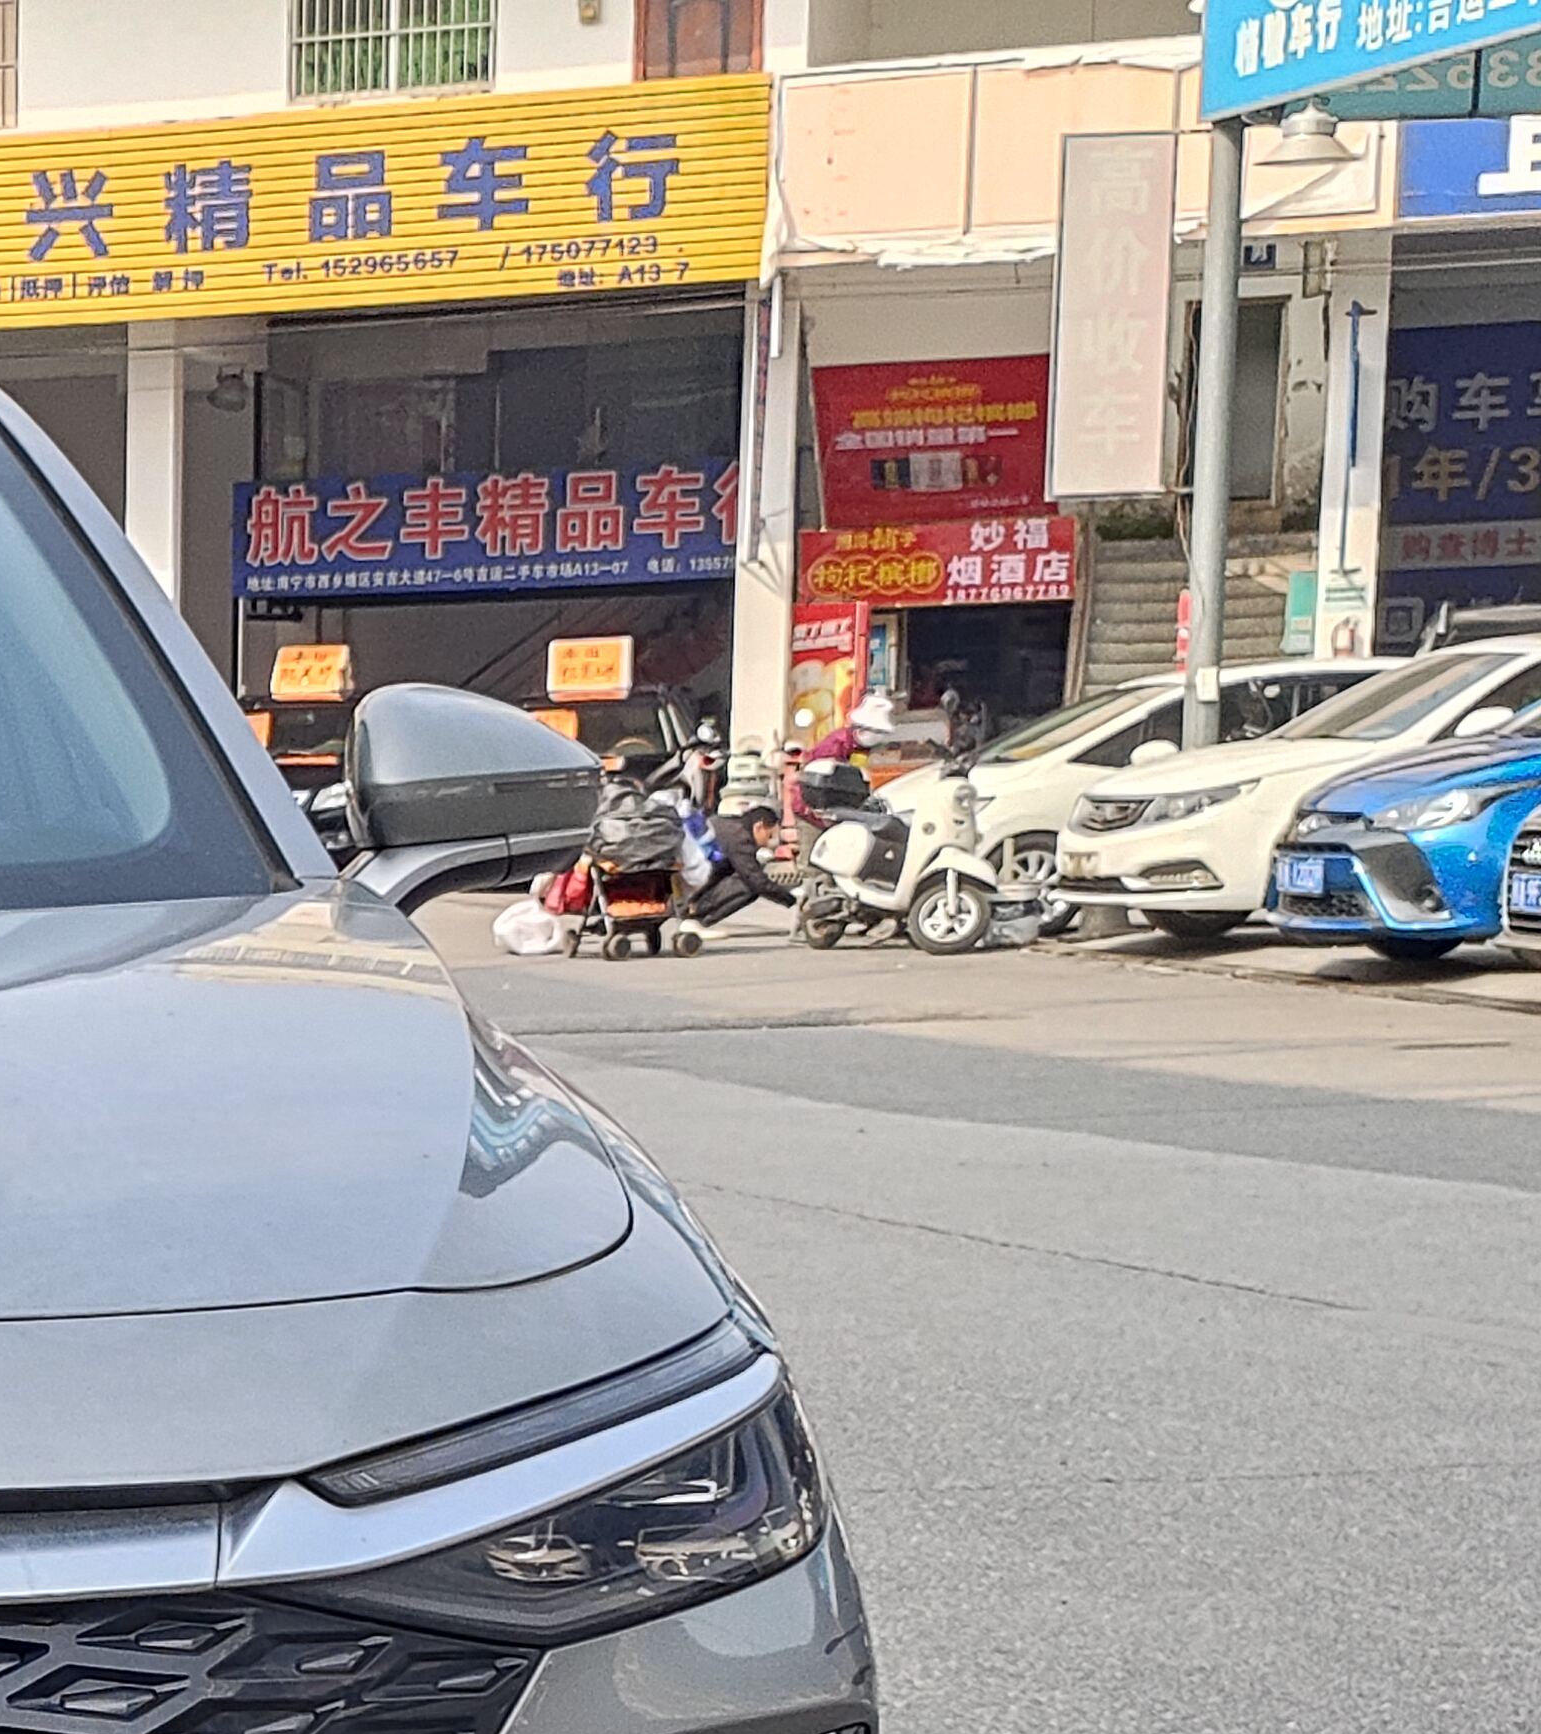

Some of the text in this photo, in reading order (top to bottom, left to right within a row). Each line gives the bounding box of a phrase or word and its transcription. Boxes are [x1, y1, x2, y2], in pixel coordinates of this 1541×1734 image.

[25, 130, 680, 262] 兴精品车行
[1078, 142, 1154, 456] 高价收车
[1388, 372, 1541, 433] 购车
[969, 518, 1049, 552] 妙福
[946, 550, 1070, 587] 烟酒店
